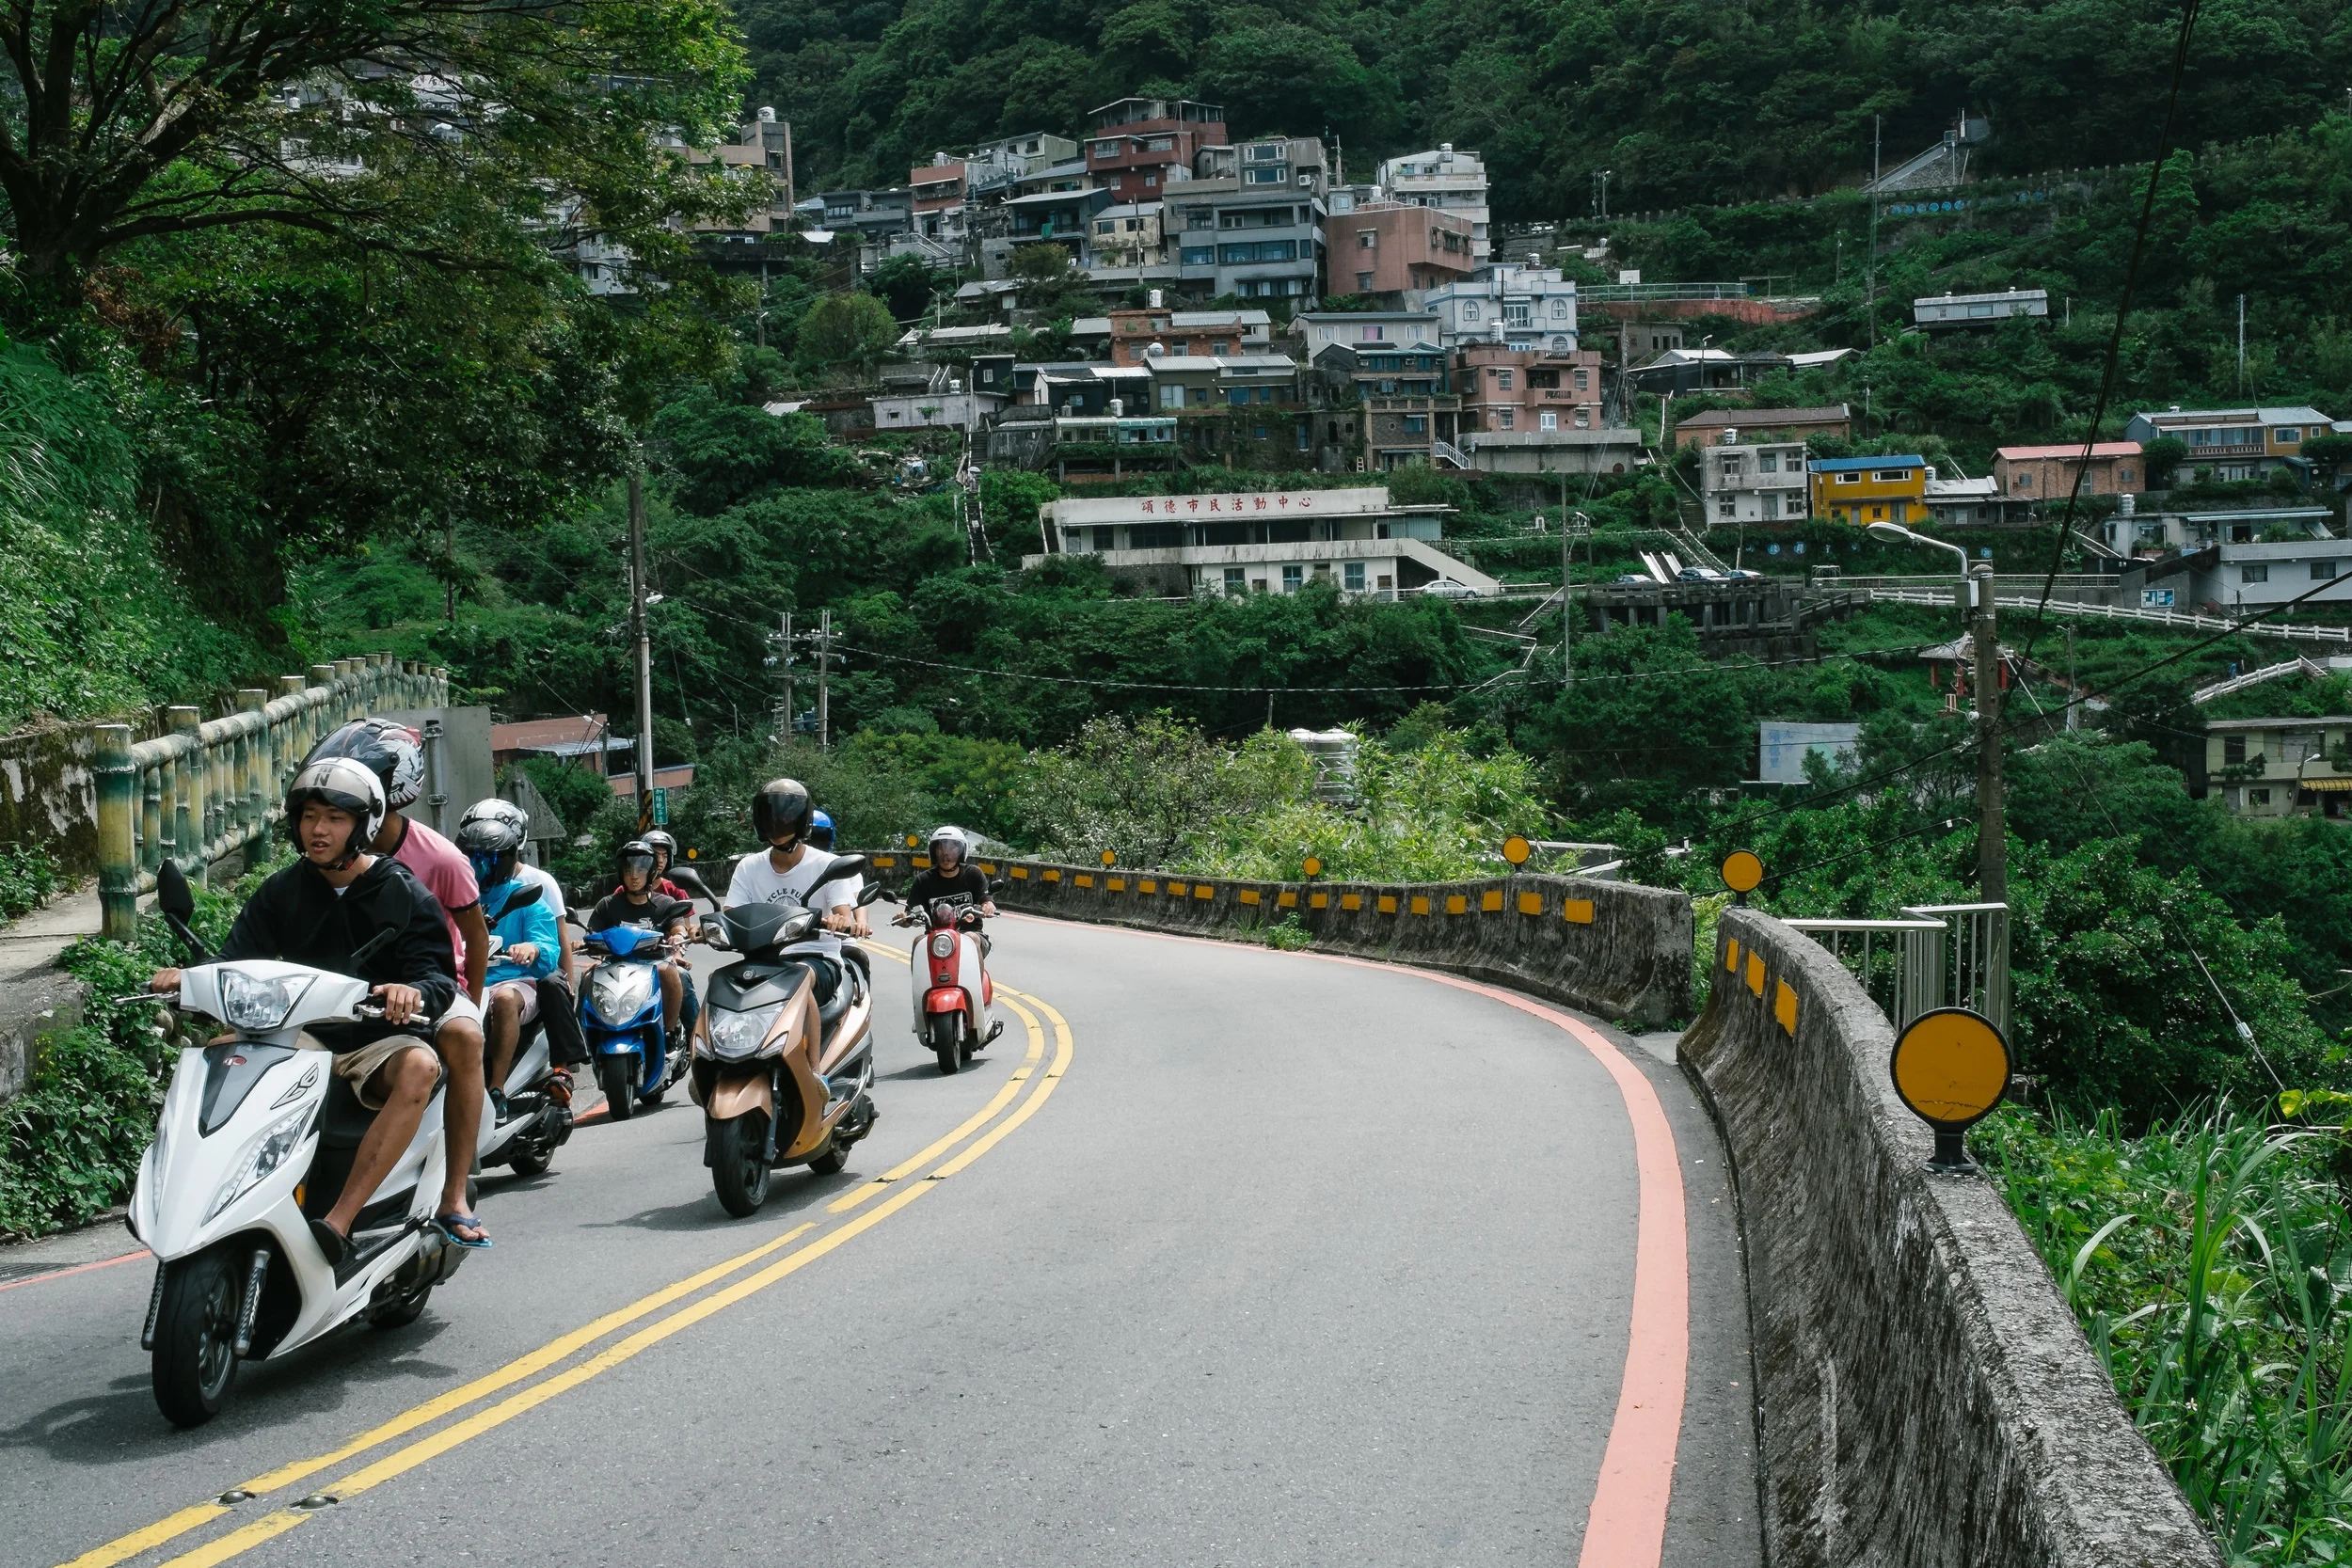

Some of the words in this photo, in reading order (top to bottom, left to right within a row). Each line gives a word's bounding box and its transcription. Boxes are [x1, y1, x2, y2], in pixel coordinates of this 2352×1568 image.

[1141, 495, 1311, 514] 頌德市民活動中心
[767, 888, 787, 903] YCLE
[790, 888, 802, 900] FU
